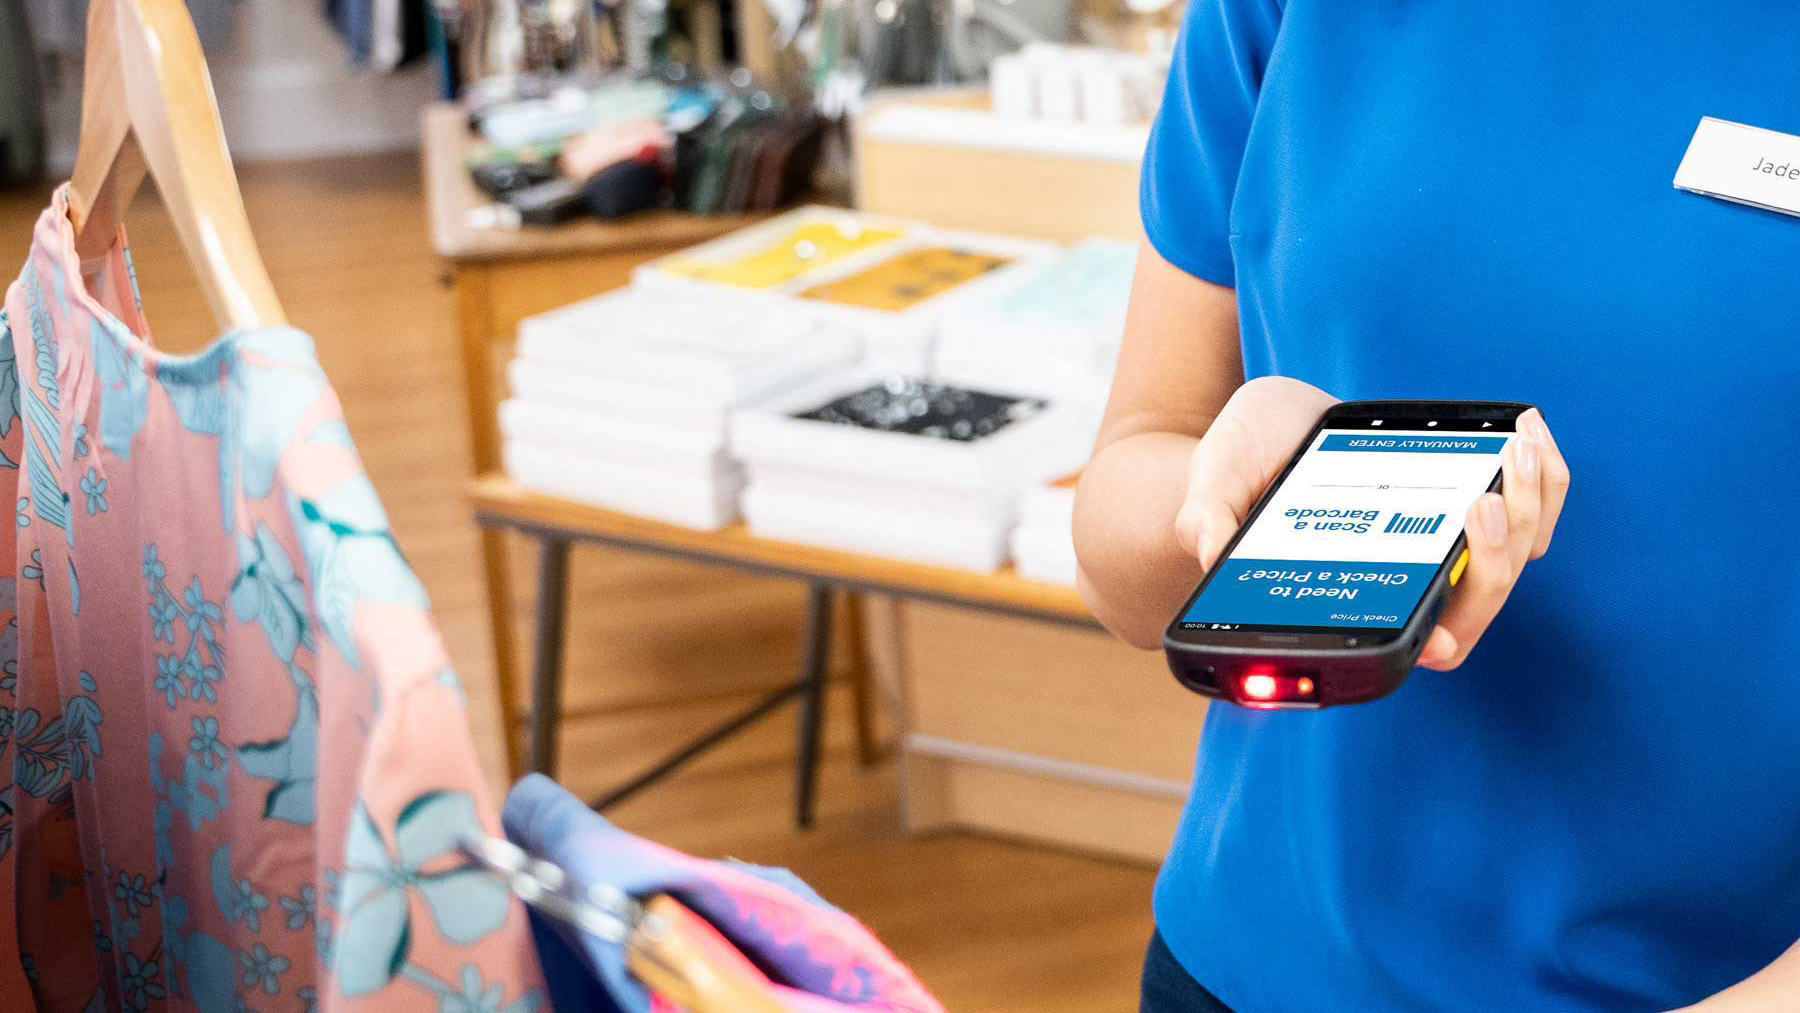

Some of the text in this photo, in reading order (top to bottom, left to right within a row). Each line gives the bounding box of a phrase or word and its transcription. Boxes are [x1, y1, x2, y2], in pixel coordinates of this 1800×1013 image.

[1752, 157, 1800, 180] Jade
[1348, 439, 1478, 448] MANUALLY ENTER
[1284, 508, 1380, 521] Barcode
[1293, 521, 1371, 534] Scan a
[1238, 569, 1409, 586] Check a Price?
[1268, 586, 1359, 599] Need to
[1330, 613, 1398, 622] Check Price
